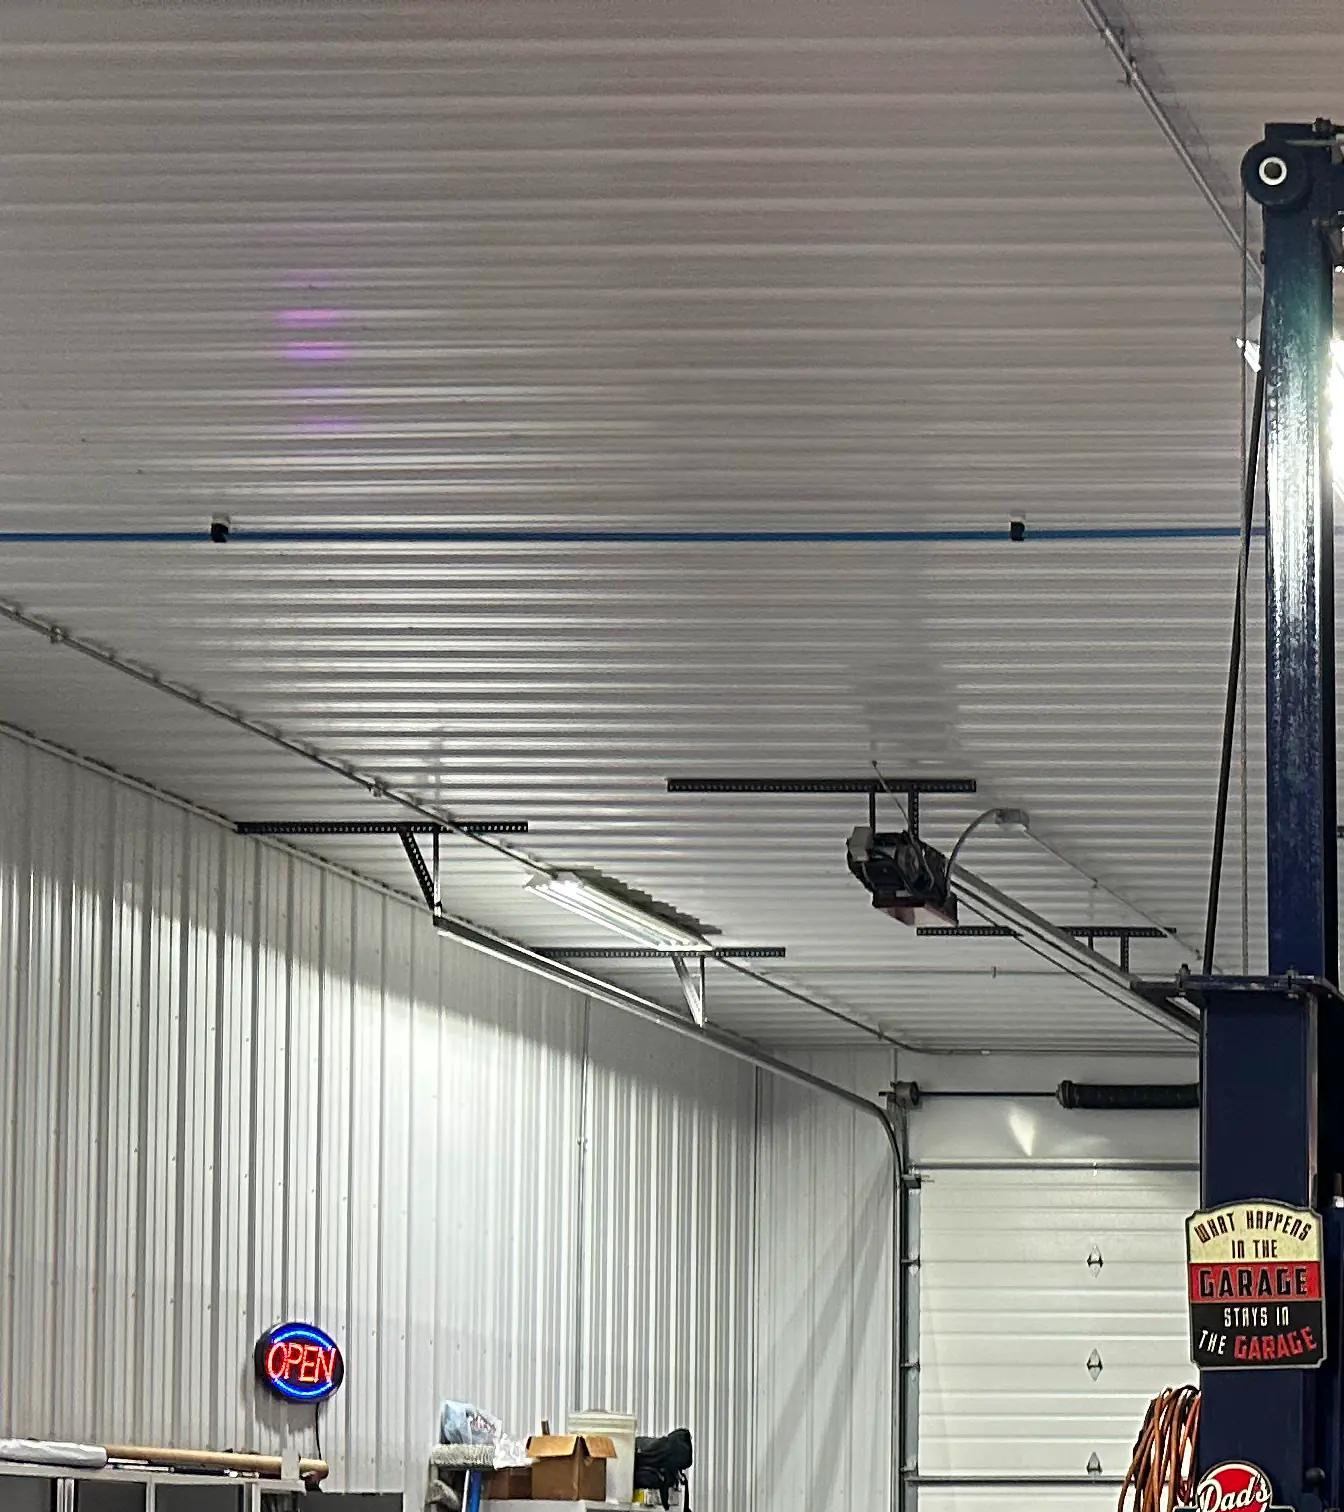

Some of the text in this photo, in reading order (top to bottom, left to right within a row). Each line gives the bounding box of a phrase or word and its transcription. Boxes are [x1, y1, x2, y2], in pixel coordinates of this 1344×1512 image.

[1194, 1210, 1312, 1243] WHAT HAPPENS
[1231, 1239, 1278, 1259] IN THE
[1199, 1267, 1308, 1298] GARAGE
[1224, 1306, 1289, 1327] STAYS IN
[1199, 1326, 1317, 1360] THE GARAGE
[267, 1342, 337, 1383] OPEN
